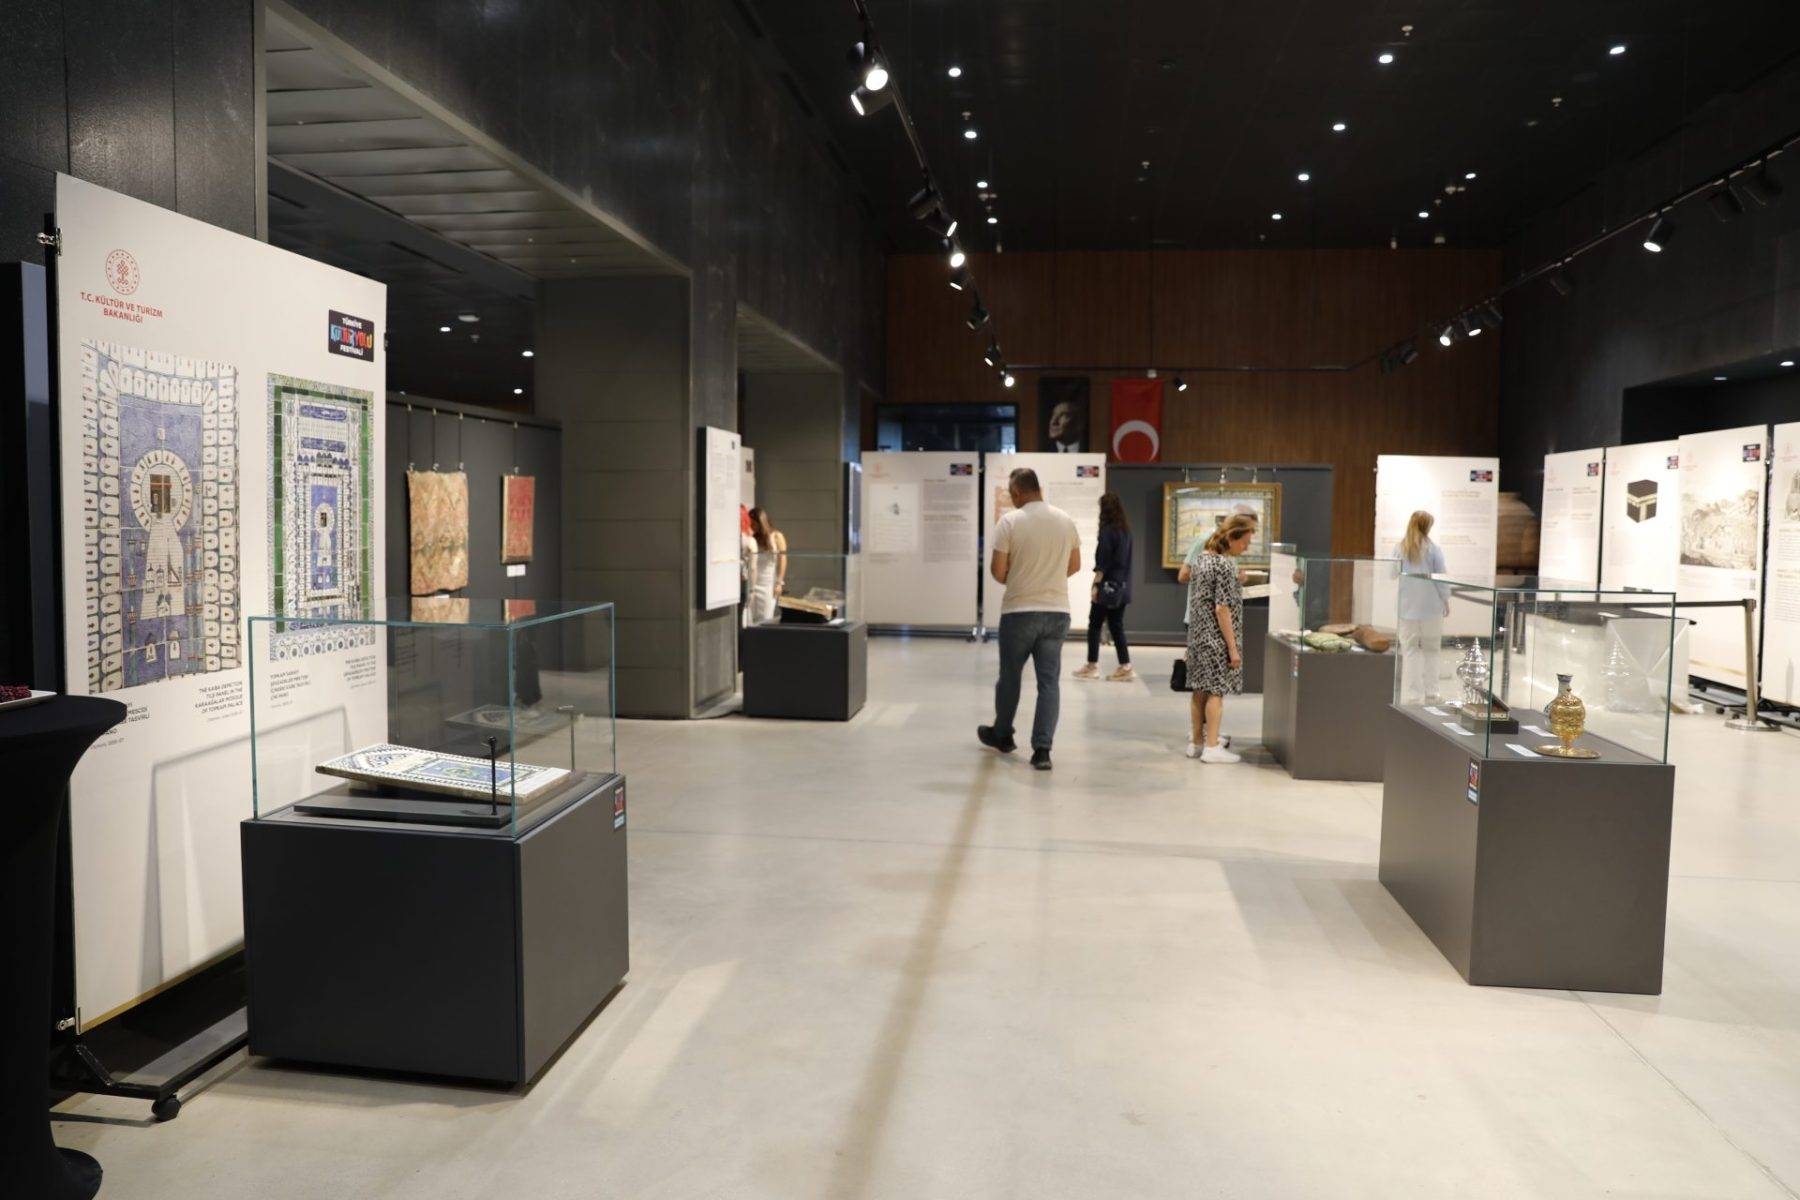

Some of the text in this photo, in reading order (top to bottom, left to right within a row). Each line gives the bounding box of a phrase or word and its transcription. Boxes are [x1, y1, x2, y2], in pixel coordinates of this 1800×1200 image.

[95, 295, 125, 308] KÜLTÜR
[126, 303, 135, 311] VE
[137, 305, 163, 317] TURİZM
[103, 308, 143, 323] BAKANLIĞI
